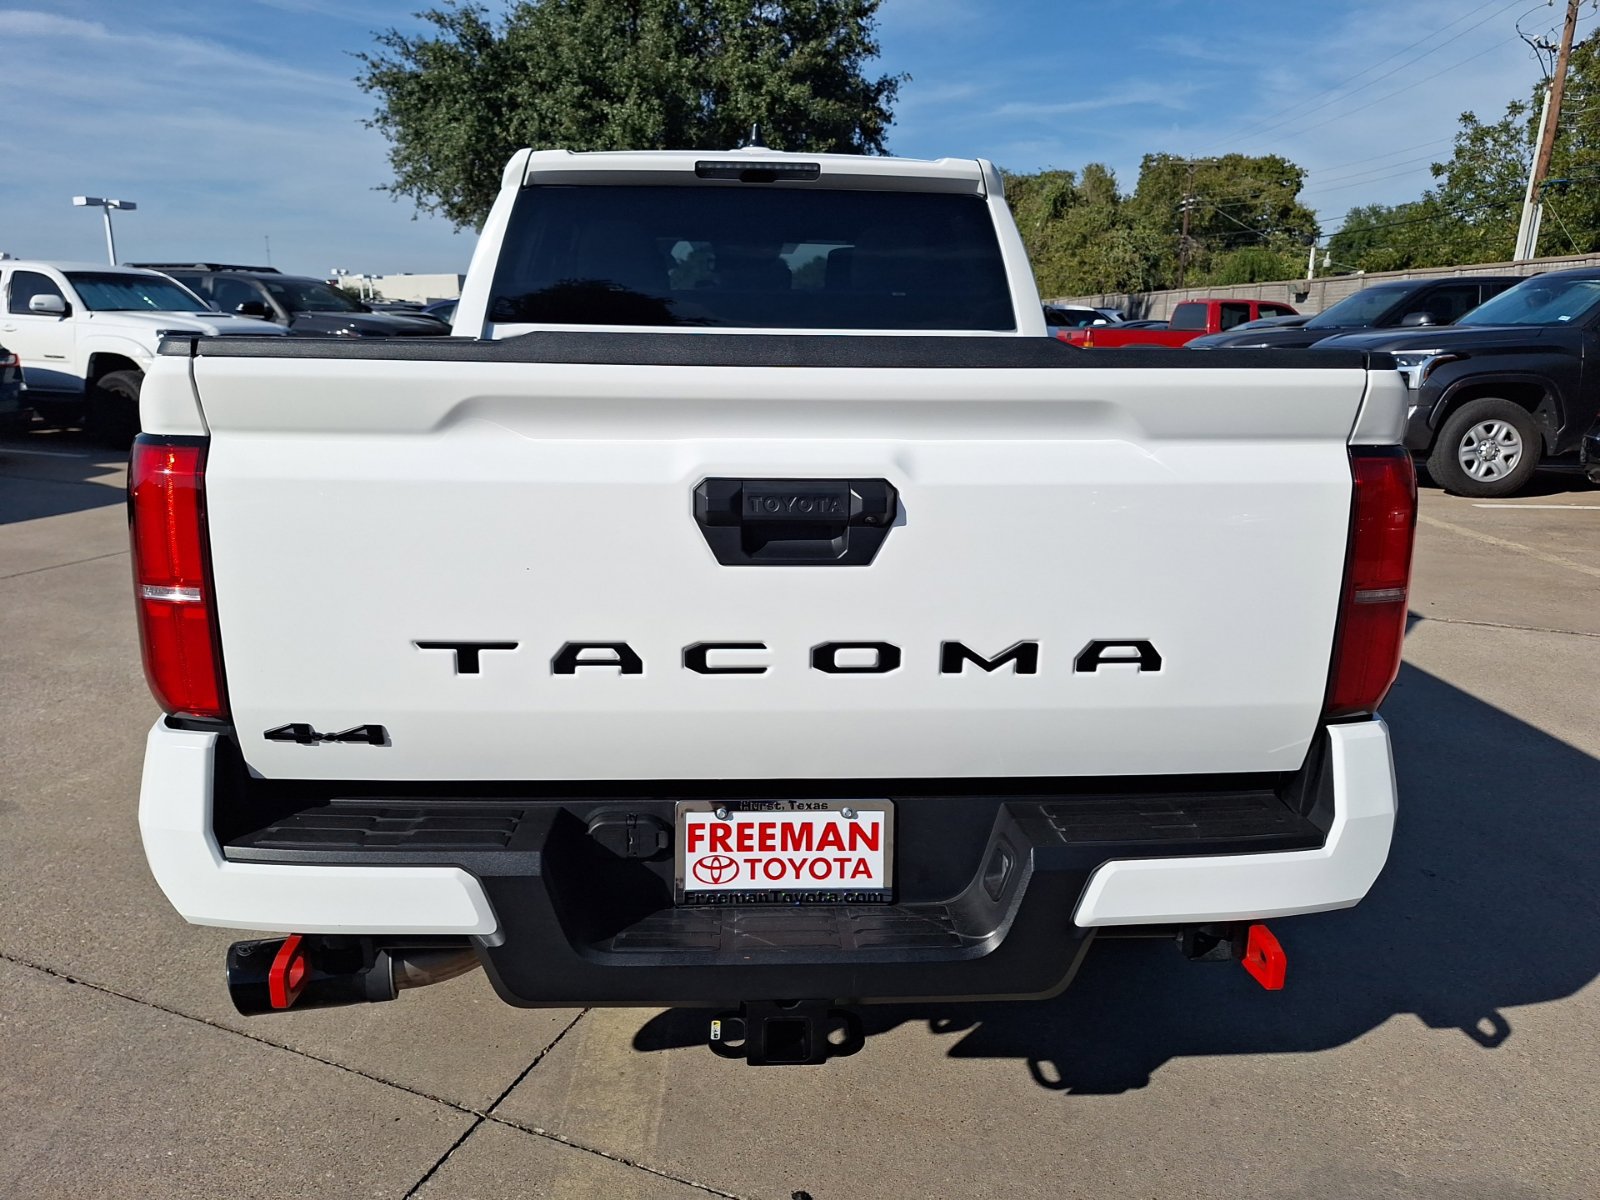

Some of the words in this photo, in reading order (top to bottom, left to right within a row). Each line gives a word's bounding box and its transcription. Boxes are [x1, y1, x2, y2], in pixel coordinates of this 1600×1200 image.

[750, 495, 845, 514] TOYOTA
[412, 639, 1163, 675] TACOMA
[788, 800, 829, 811] Texas
[687, 821, 880, 853] FREEMAN
[743, 857, 873, 881] TOYOTA
[683, 889, 885, 904] FreemanToyota.com
